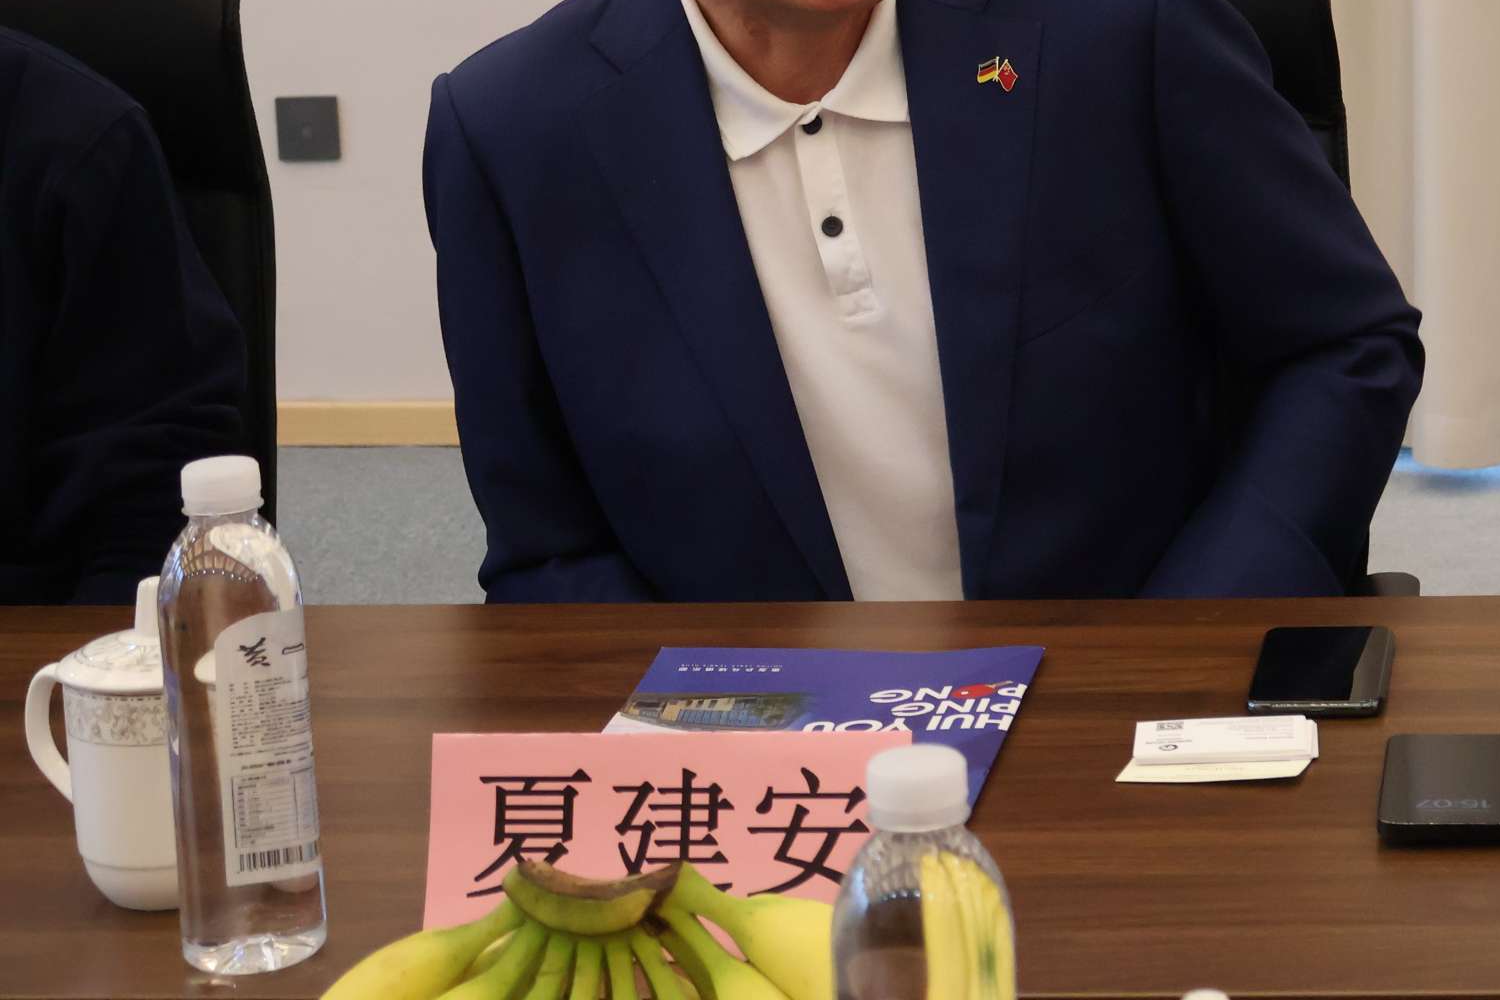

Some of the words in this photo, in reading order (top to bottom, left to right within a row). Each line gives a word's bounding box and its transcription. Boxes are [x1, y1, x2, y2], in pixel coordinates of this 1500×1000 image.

[891, 699, 1020, 717] PING
[802, 719, 913, 733] YOU
[926, 714, 1013, 731] HUI
[467, 766, 871, 897] 夏建安
